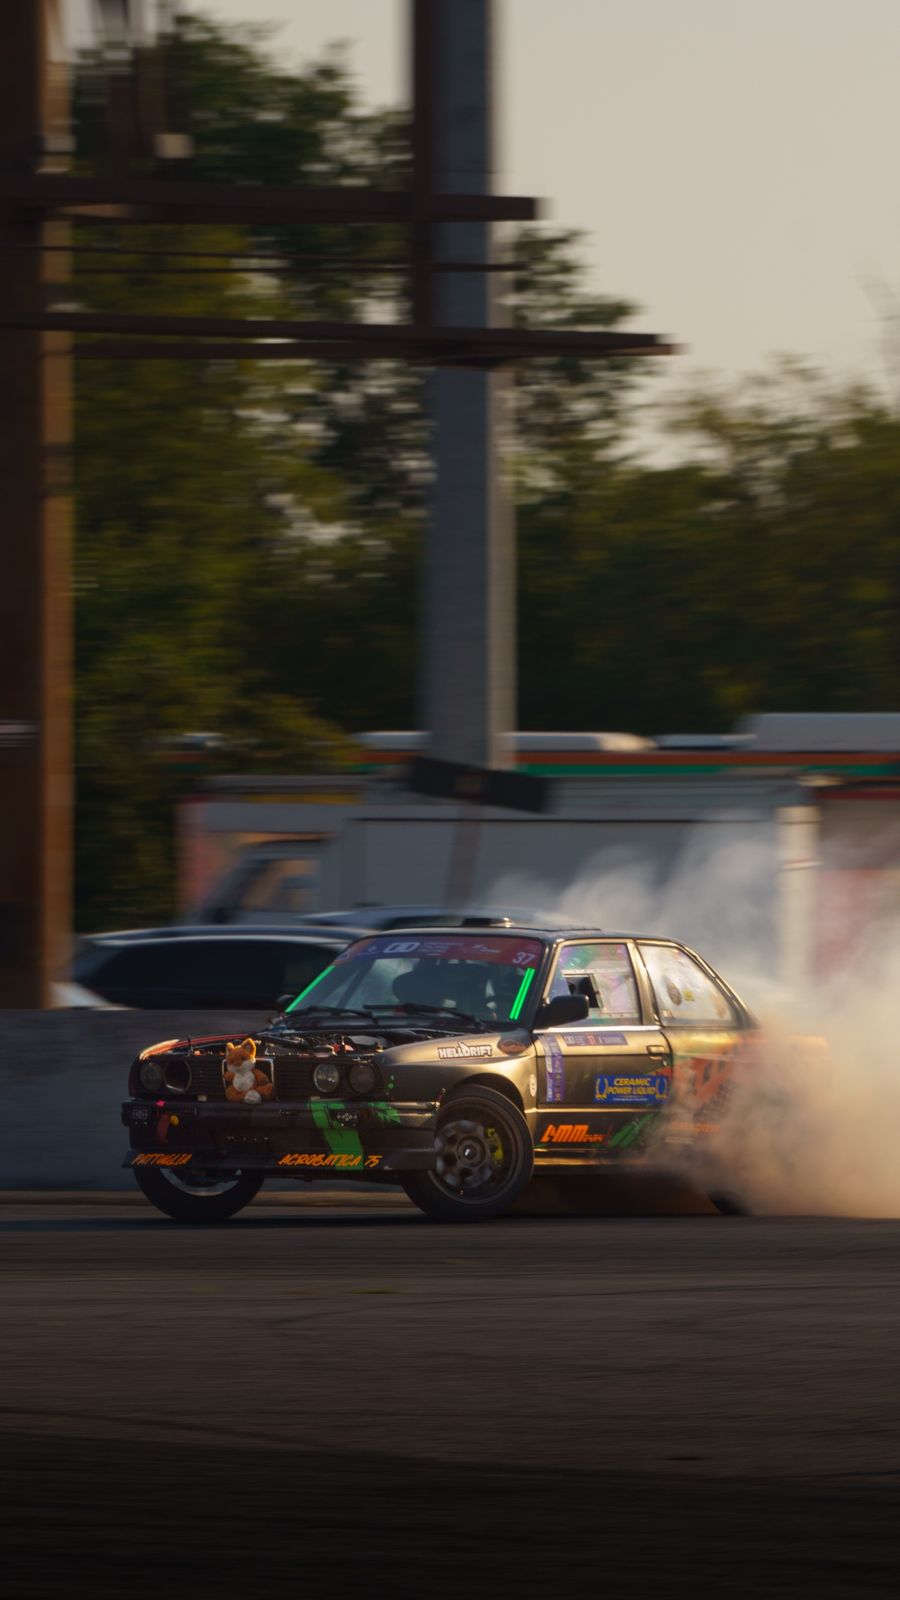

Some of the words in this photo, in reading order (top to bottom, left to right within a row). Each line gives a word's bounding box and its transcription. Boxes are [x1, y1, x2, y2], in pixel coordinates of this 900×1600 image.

[512, 951, 536, 965] 37
[438, 1044, 492, 1059] HELLDRIFT
[614, 1077, 651, 1086] CERAMIC
[607, 1087, 632, 1095] POWER
[278, 1153, 362, 1166] ACROBATICA
[365, 1154, 383, 1168] 75
